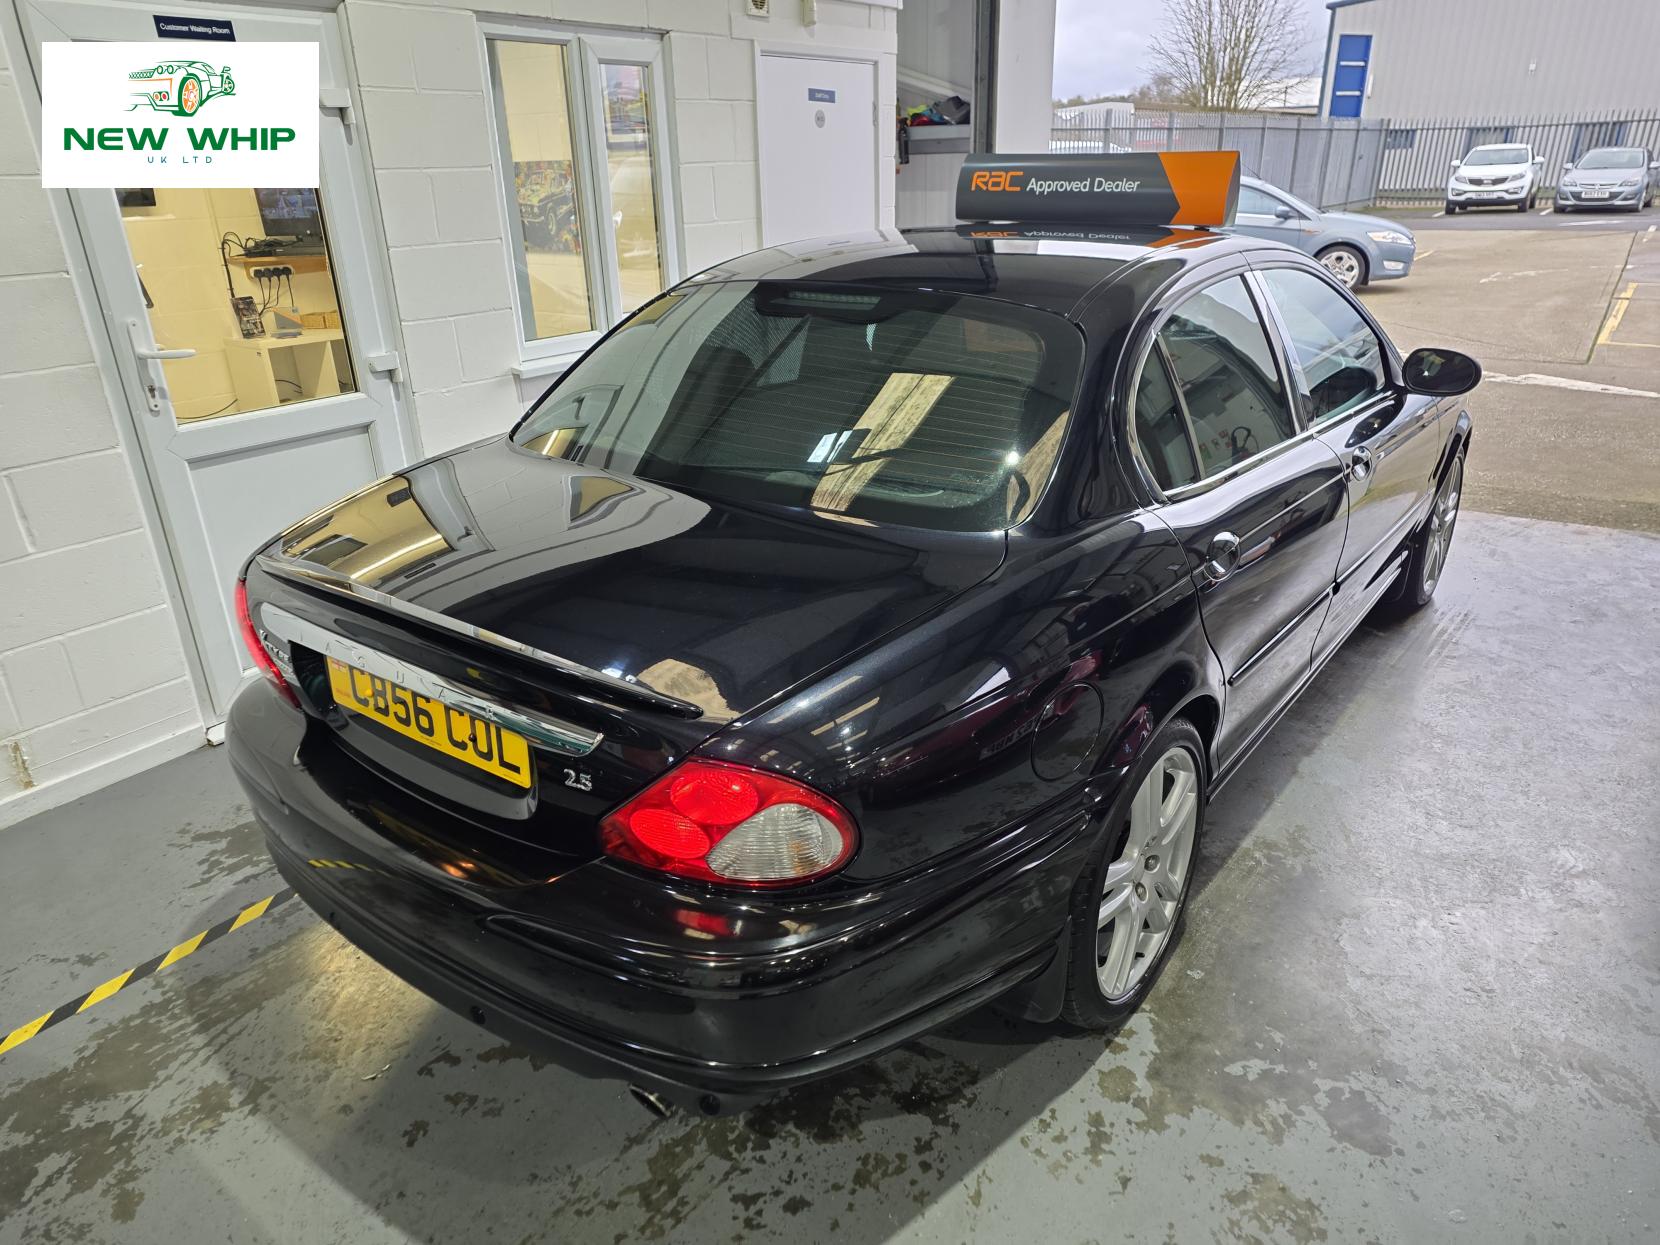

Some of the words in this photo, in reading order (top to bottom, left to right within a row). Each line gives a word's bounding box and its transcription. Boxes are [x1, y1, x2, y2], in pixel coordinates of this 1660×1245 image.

[159, 22, 189, 32] Customer
[189, 24, 212, 35] Waiting
[212, 26, 231, 35] Room
[1026, 177, 1090, 195] Approved
[1093, 177, 1140, 193] Dealer
[347, 664, 435, 738] CB56
[443, 703, 521, 775] COL
[563, 768, 593, 791] 2.5
